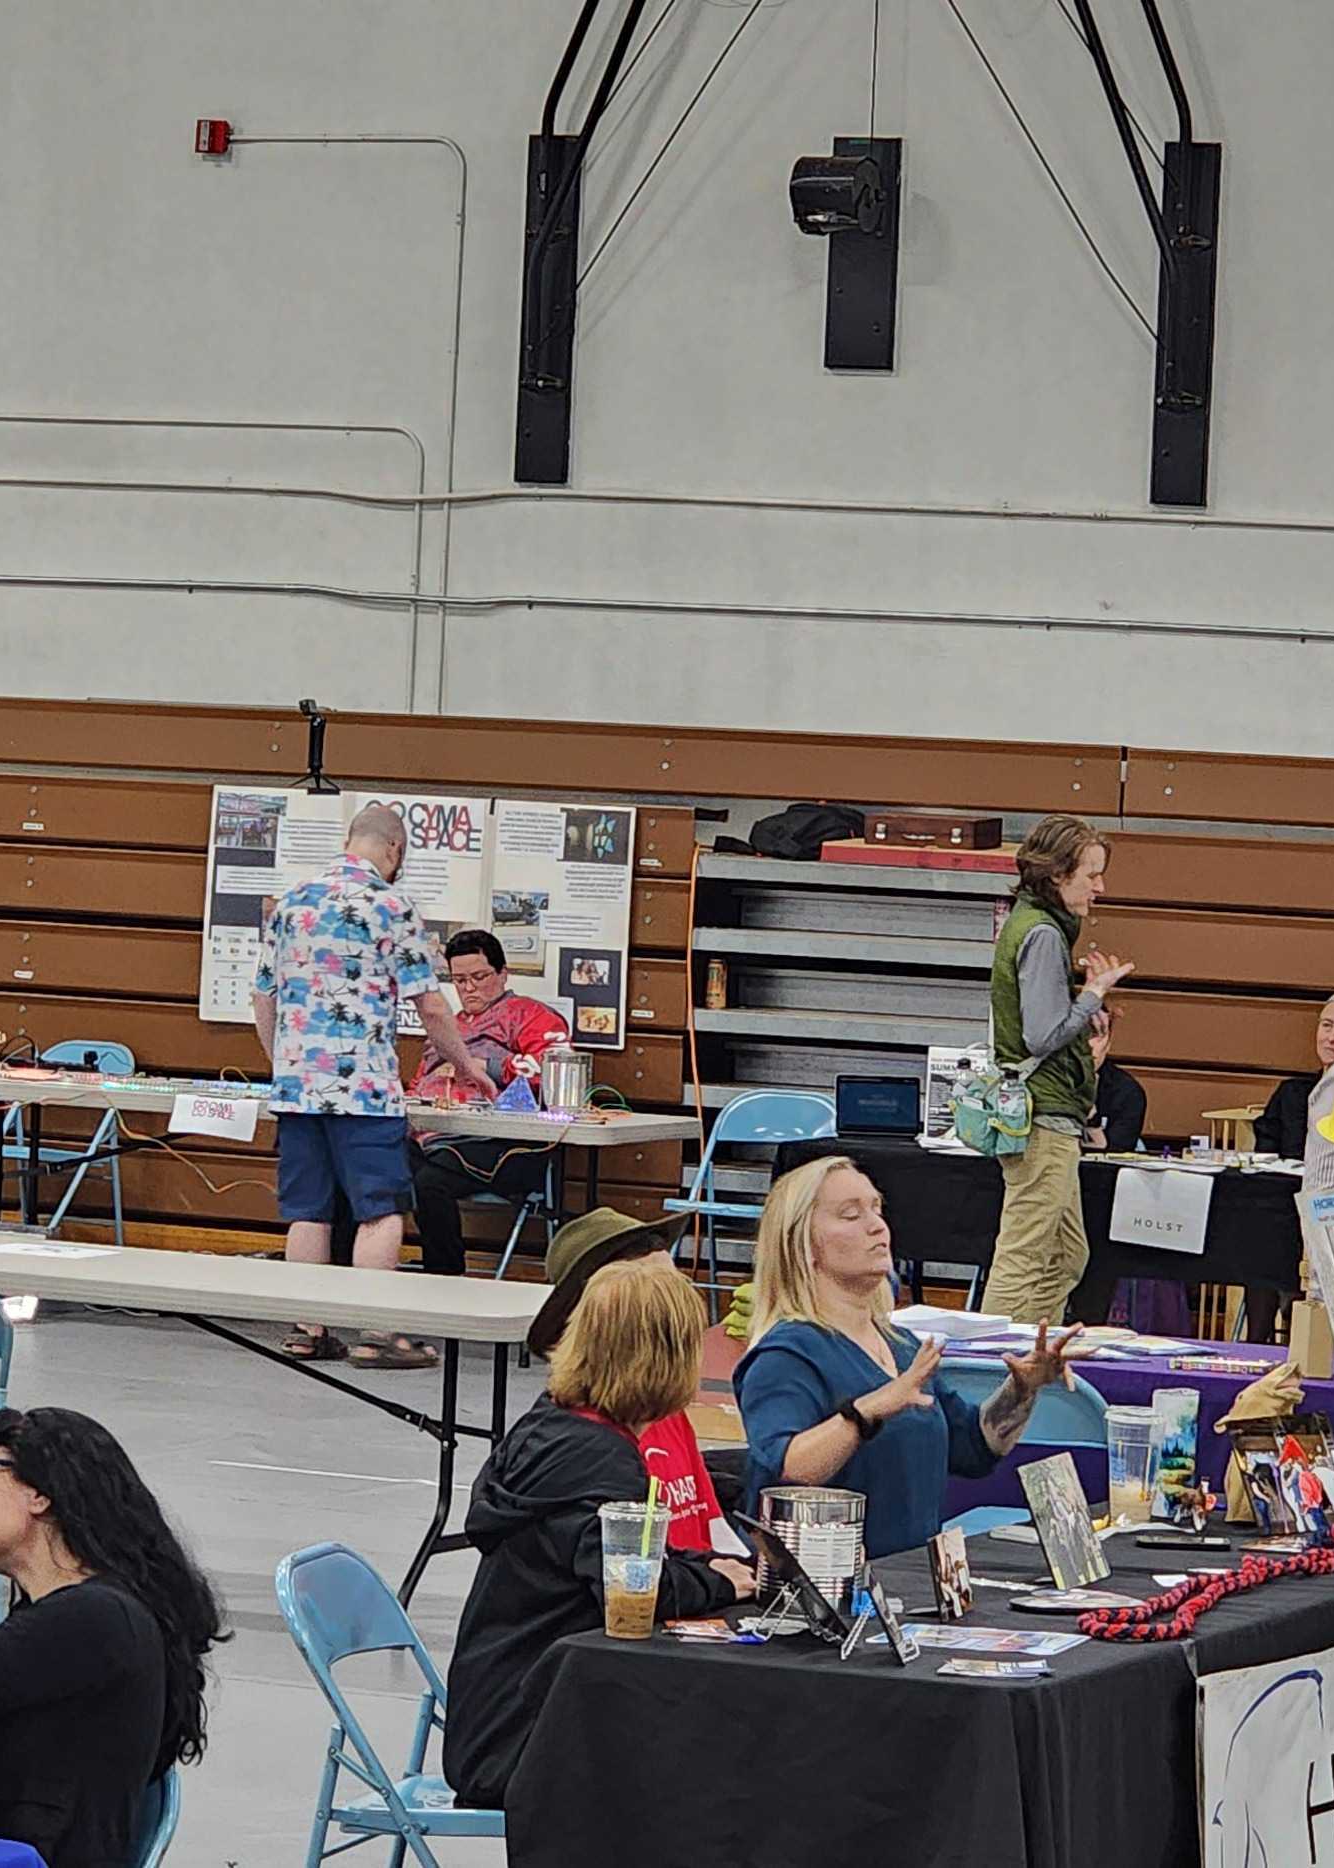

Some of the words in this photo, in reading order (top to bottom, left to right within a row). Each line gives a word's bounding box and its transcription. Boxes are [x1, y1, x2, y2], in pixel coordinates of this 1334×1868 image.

[408, 802, 472, 830] CYMA
[410, 826, 483, 853] SPACE
[1133, 1218, 1184, 1233] HOLST
